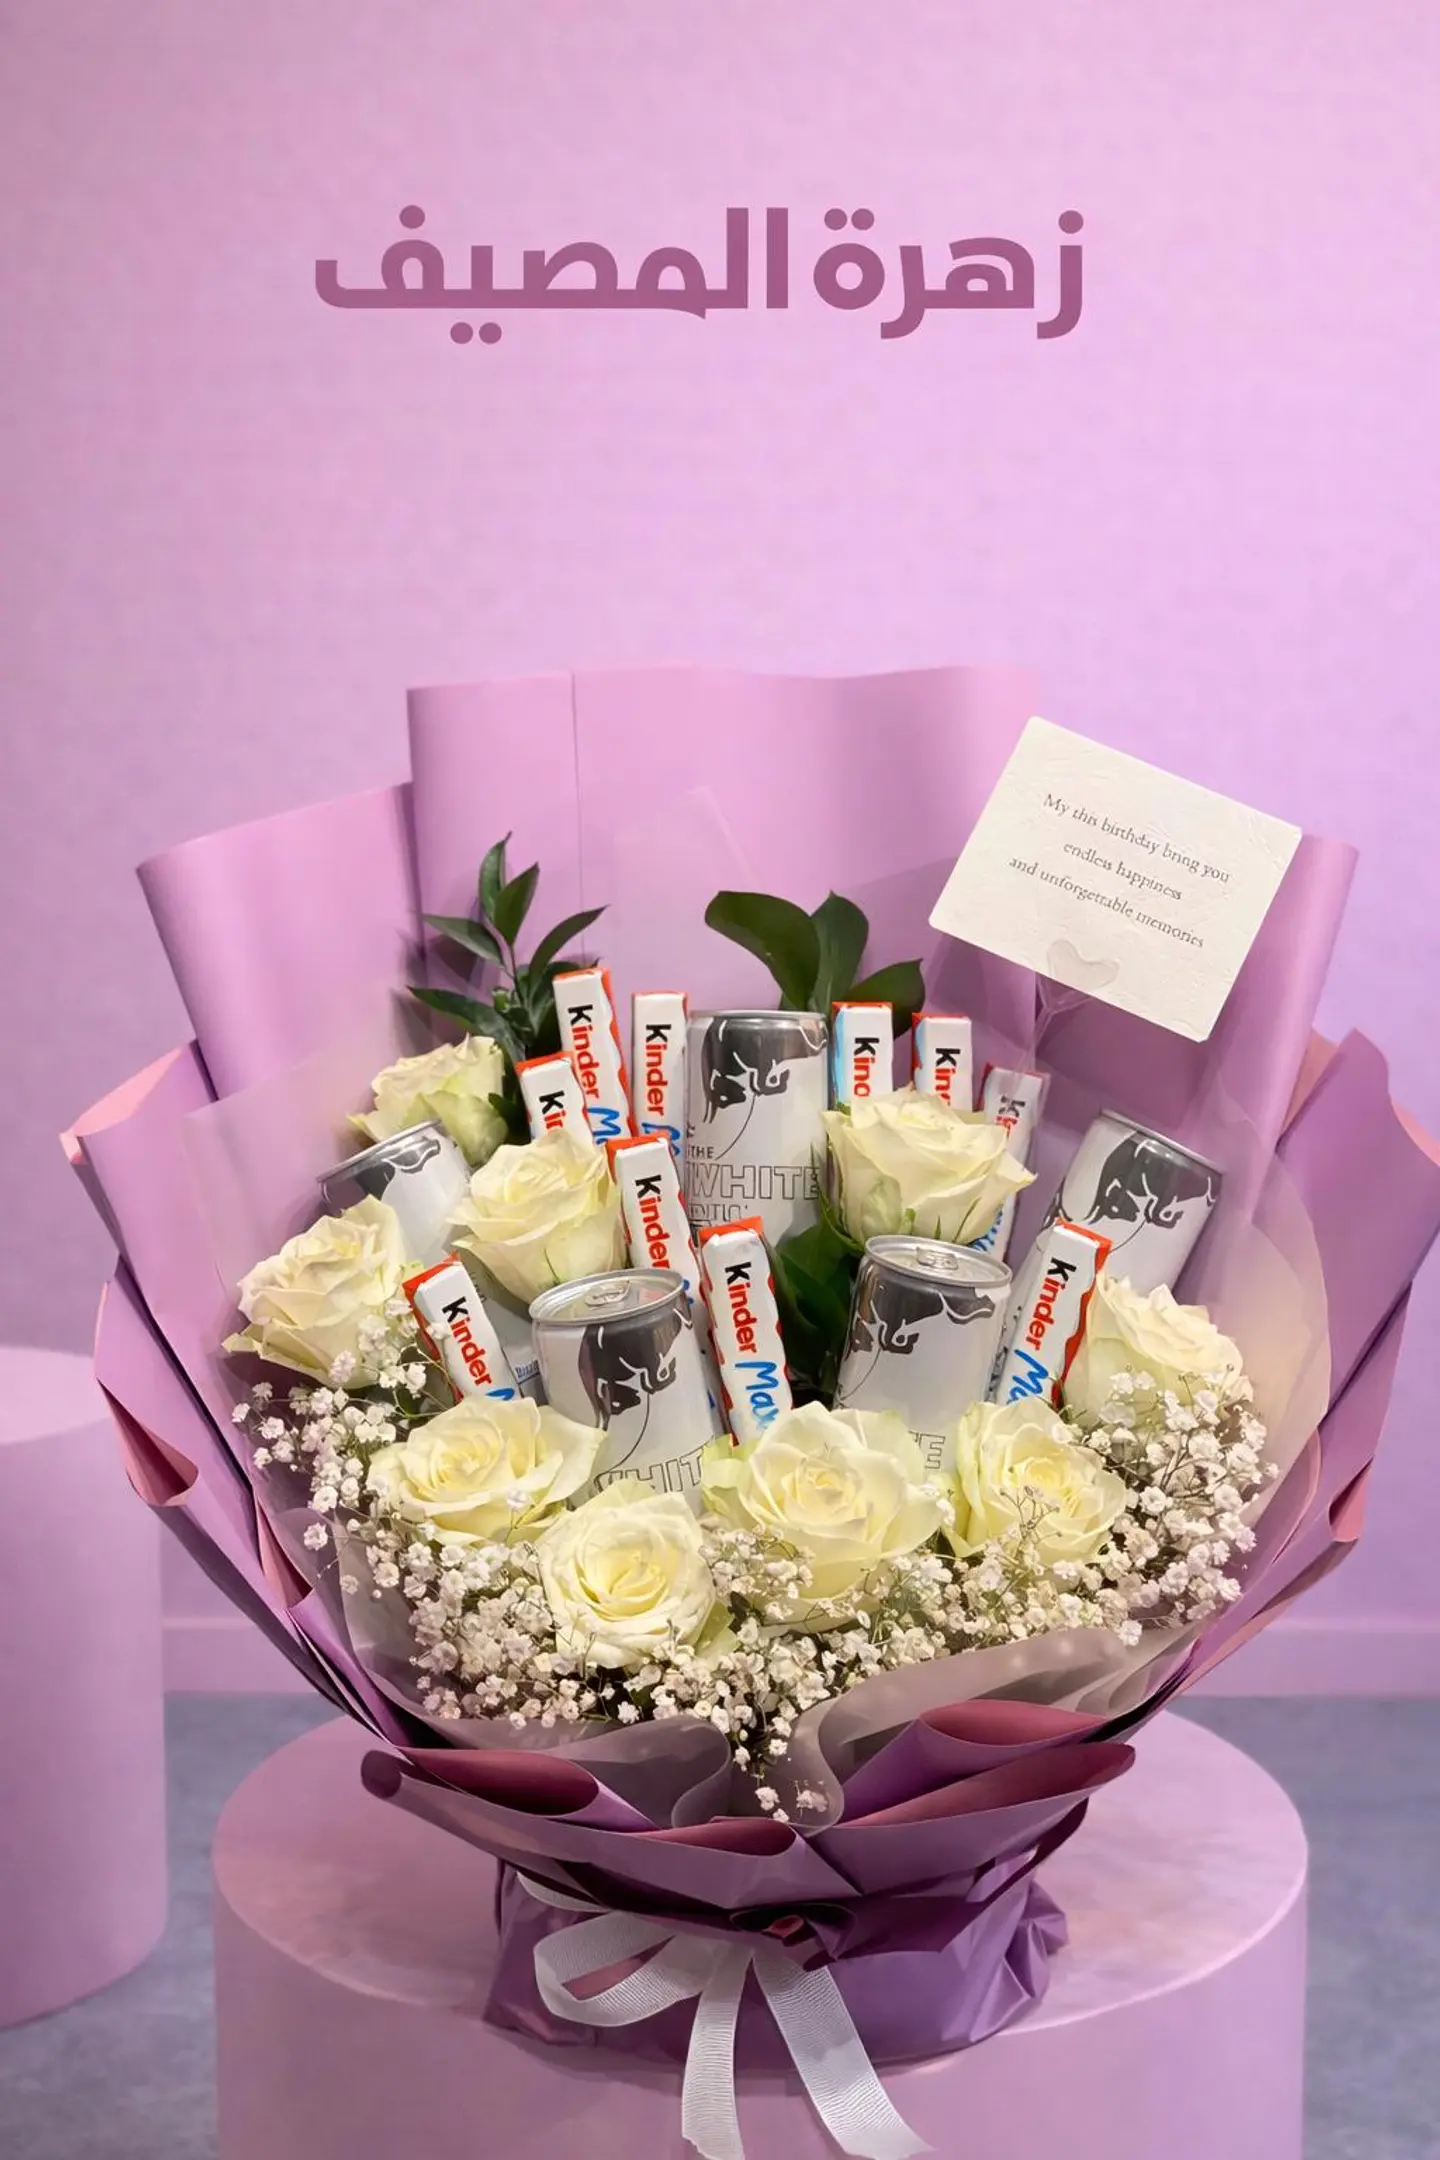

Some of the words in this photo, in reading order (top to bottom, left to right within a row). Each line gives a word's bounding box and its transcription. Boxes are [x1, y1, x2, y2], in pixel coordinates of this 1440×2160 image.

[1043, 793, 1069, 817] My
[1101, 817, 1160, 855] birthday
[1162, 843, 1200, 874] bring
[1201, 865, 1230, 883] you
[1009, 858, 1039, 876] and
[1040, 869, 1134, 918] unforgettable
[1136, 912, 1204, 948] memories
[568, 1004, 600, 1099] Kinder
[646, 1024, 672, 1116] Kinder
[635, 1174, 671, 1270] Kinder
[686, 1161, 822, 1201] WHITE
[442, 1296, 492, 1386] Kinder
[725, 1261, 757, 1353] Kinder
[1026, 1257, 1077, 1351] Kinder
